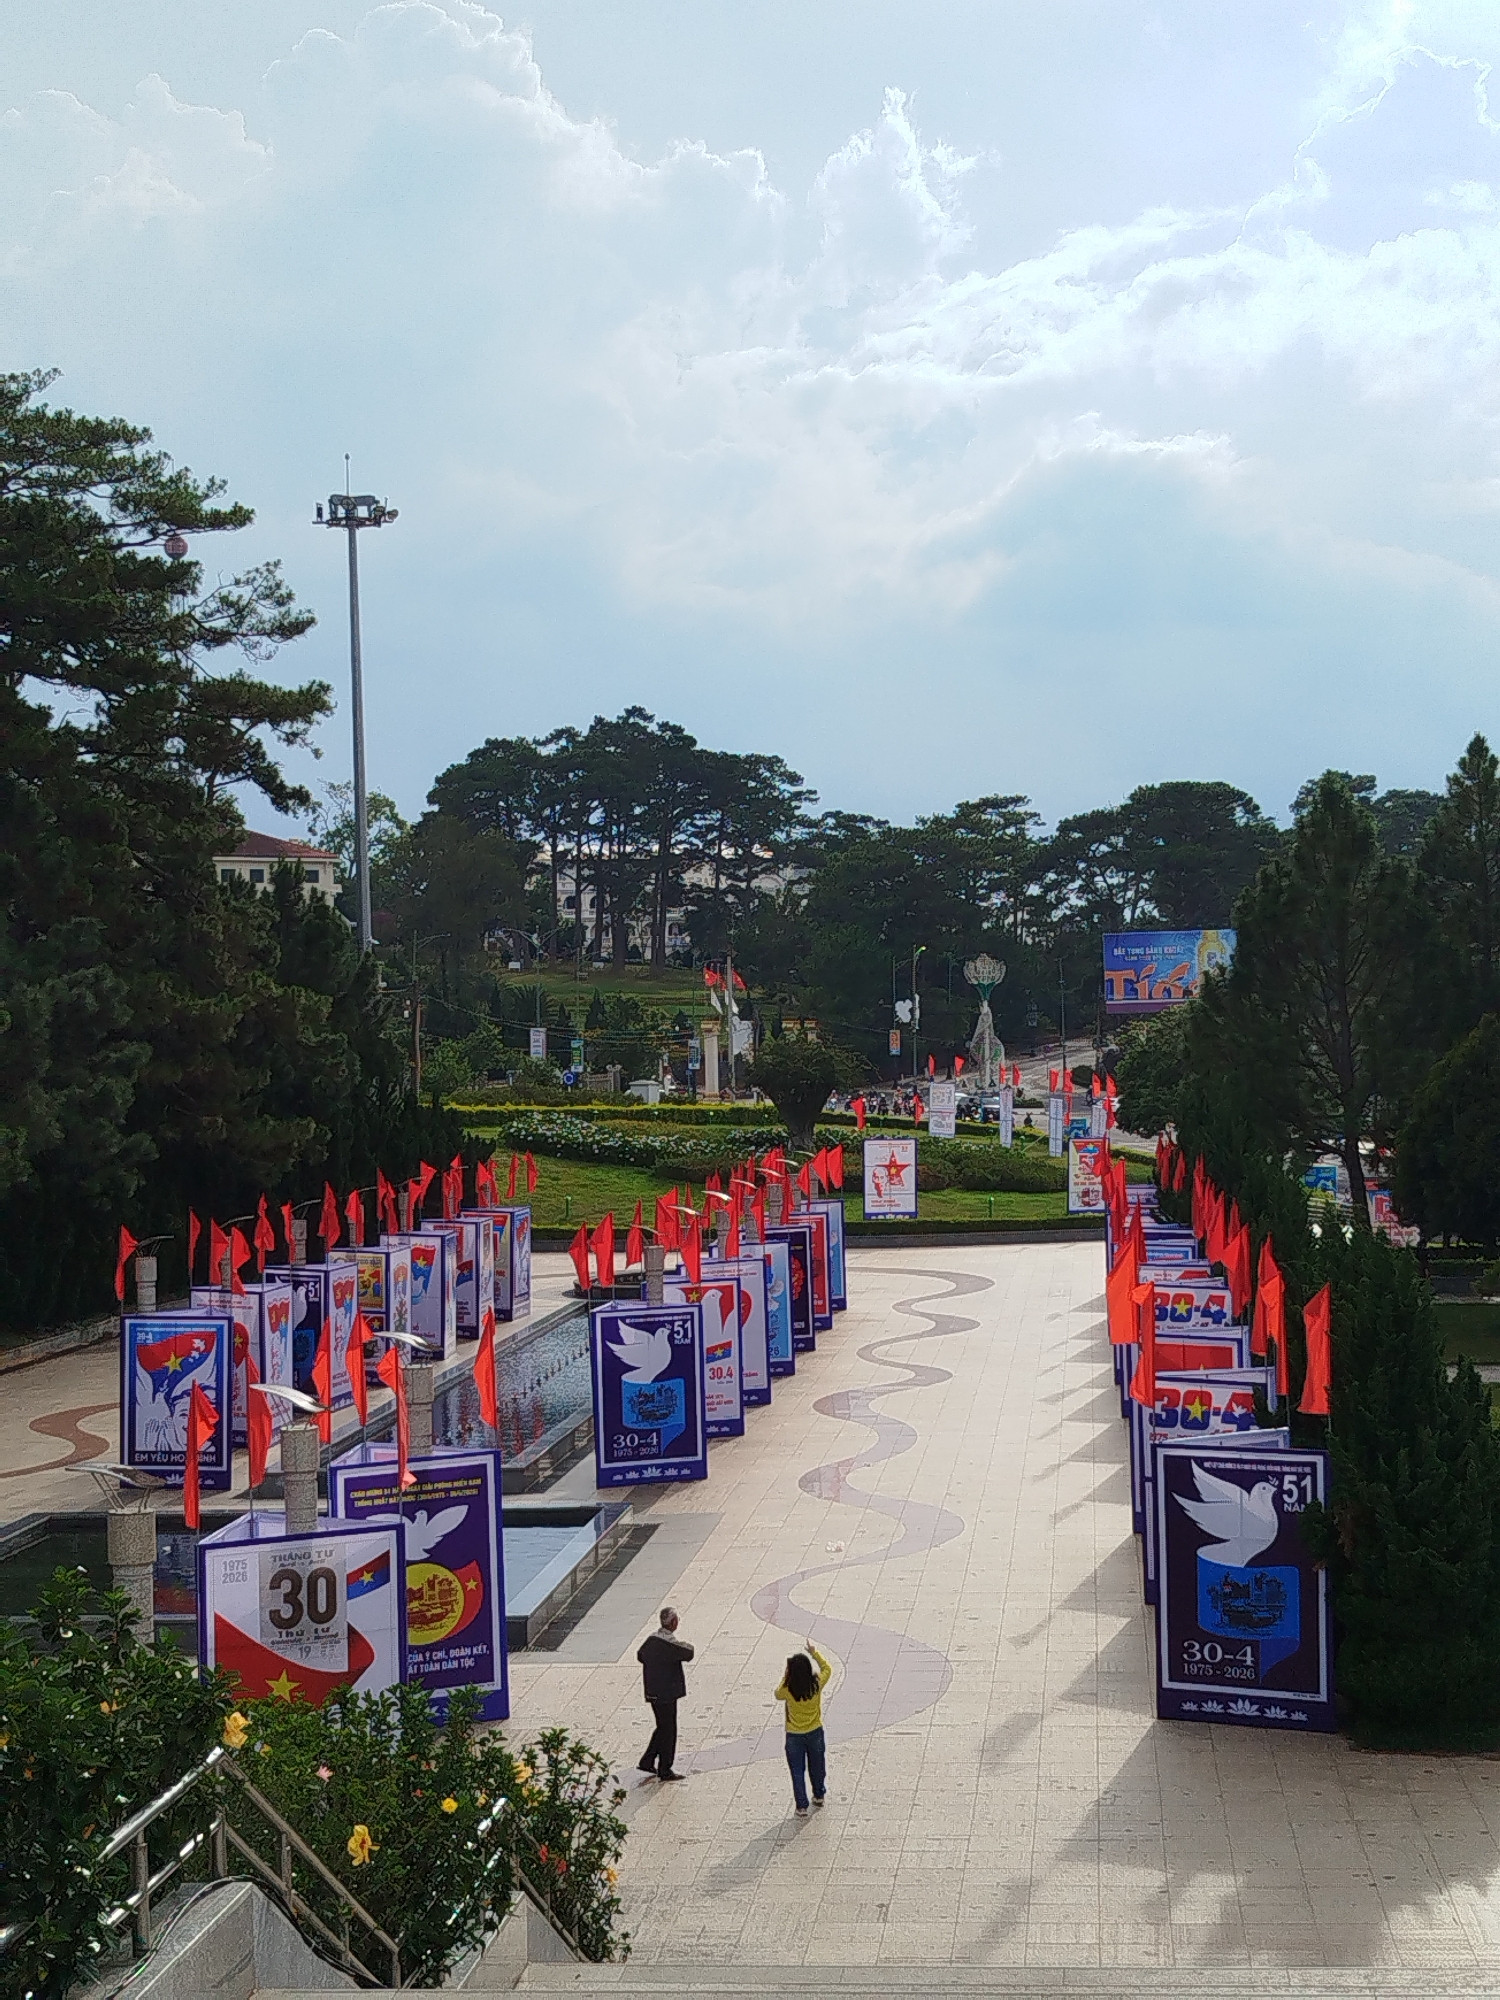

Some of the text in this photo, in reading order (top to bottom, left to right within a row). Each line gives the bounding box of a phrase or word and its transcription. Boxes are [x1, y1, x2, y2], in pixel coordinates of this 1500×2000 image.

[308, 1281, 320, 1298] 51
[673, 1319, 692, 1338] 51
[708, 1366, 734, 1380] 30.4
[1149, 1387, 1258, 1431] 30-4
[612, 1431, 659, 1449] 30-4
[134, 1453, 149, 1462] EM
[1282, 1474, 1312, 1504] 51
[1284, 1502, 1306, 1513] NĂ
[270, 1550, 312, 1563] THÁNG
[222, 1559, 248, 1572] 1975
[222, 1572, 248, 1584] 2026
[268, 1566, 338, 1630] 30
[297, 1645, 312, 1660] 19
[1182, 1639, 1255, 1667] 30-4
[1183, 1662, 1214, 1676] 1975
[1223, 1665, 1256, 1680] 2026
